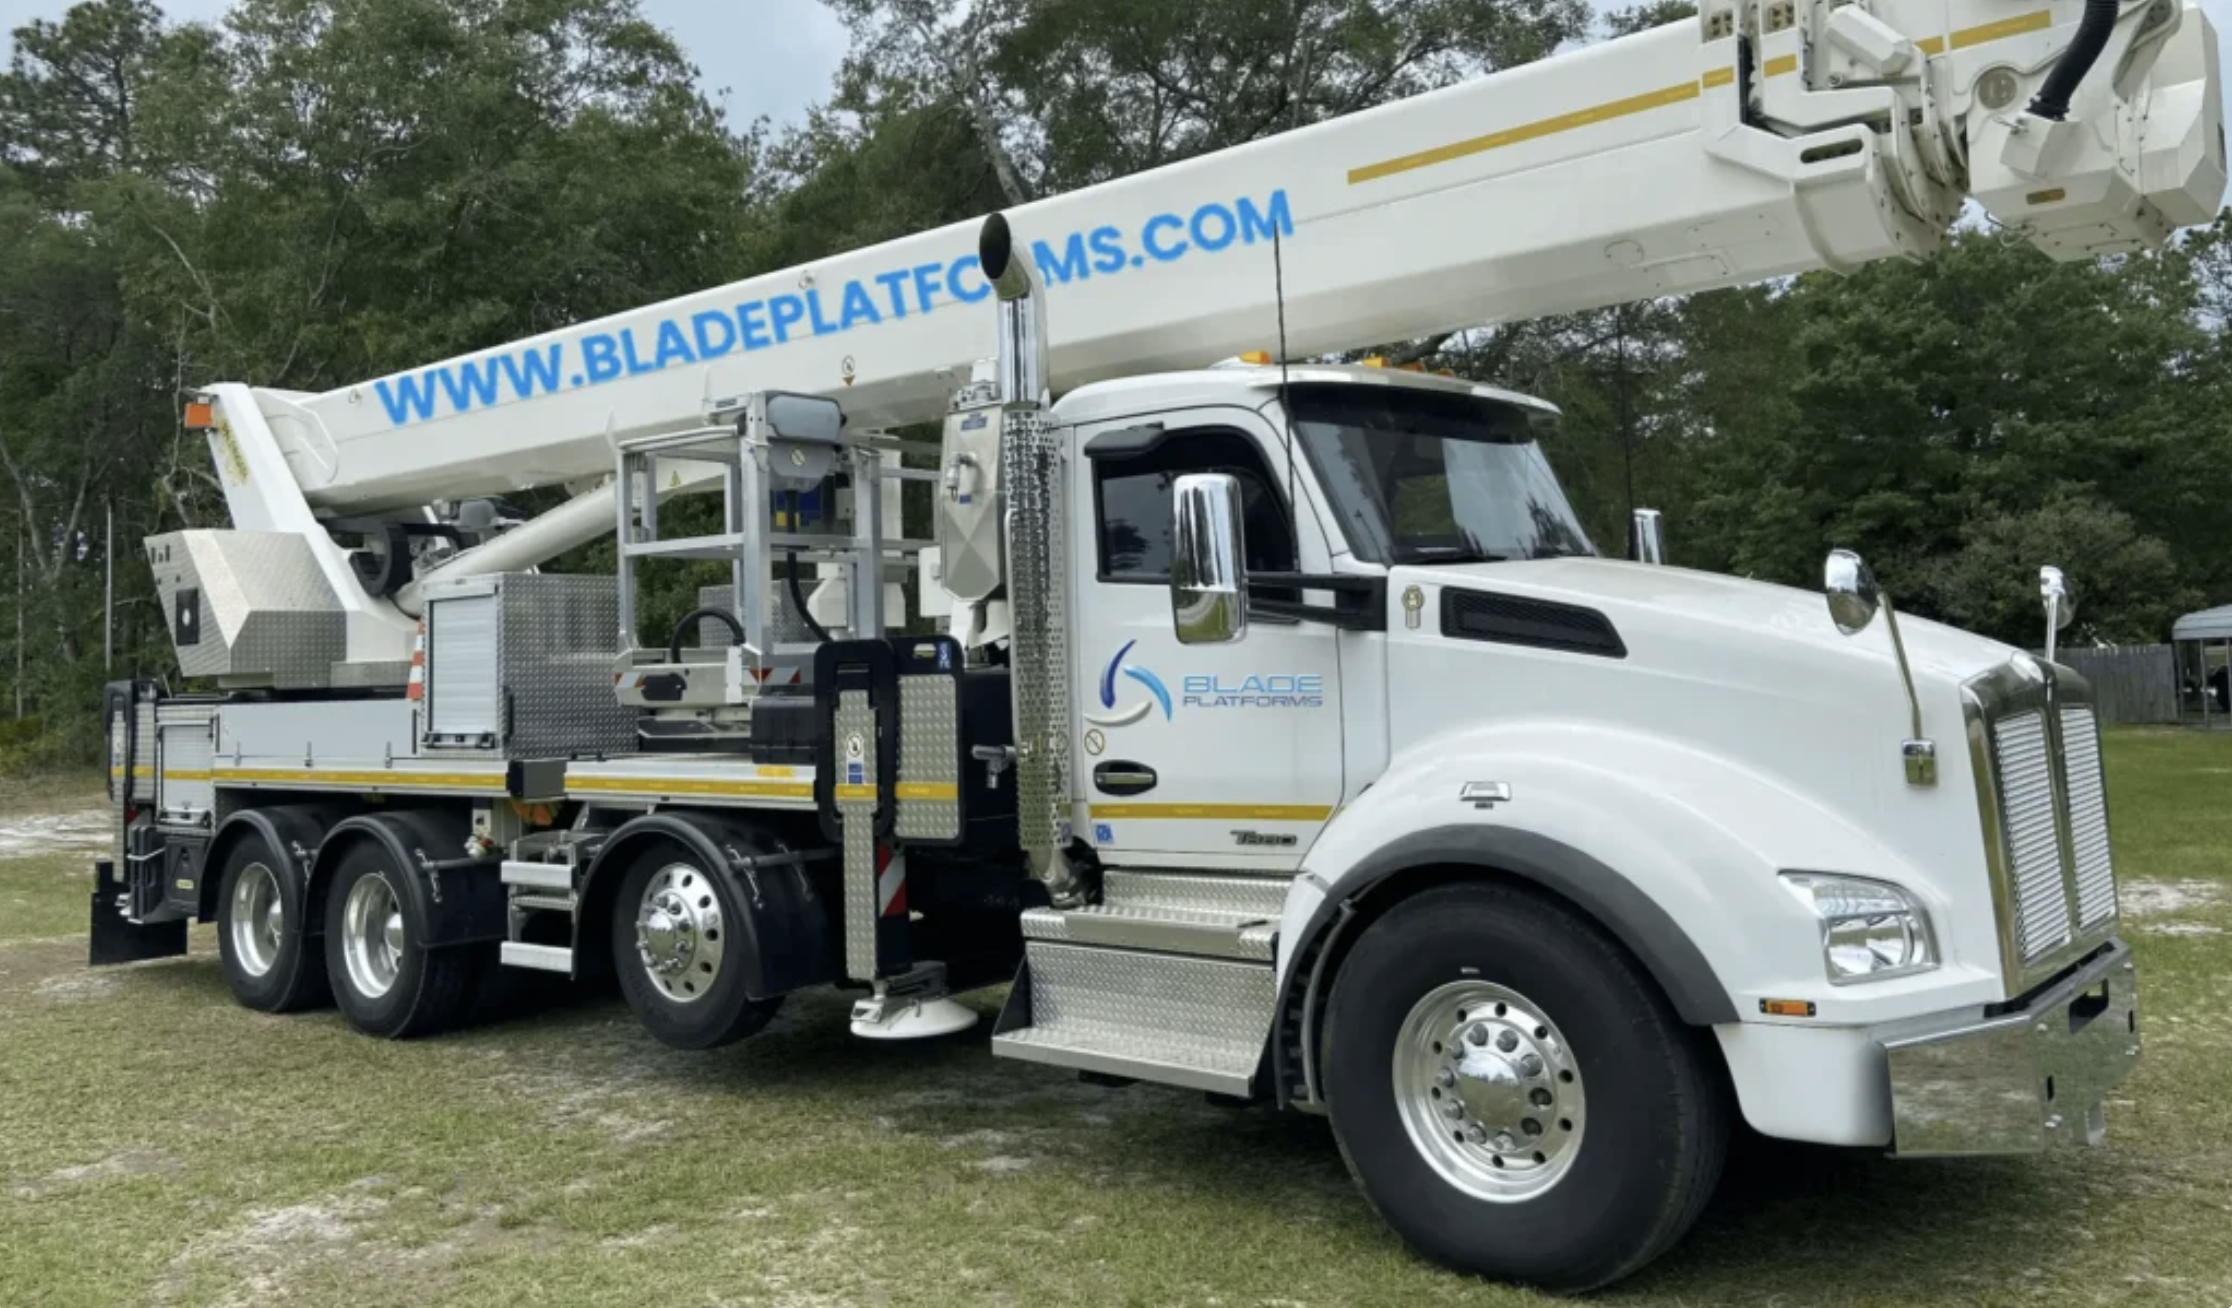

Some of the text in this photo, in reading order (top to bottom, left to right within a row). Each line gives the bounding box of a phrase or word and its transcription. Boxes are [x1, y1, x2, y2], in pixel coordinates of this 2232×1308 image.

[375, 189, 1295, 426] WWW.BLADEPLATFOMS.COM
[1183, 675, 1322, 693] BLADE
[1183, 696, 1322, 707] PLATFORMS
